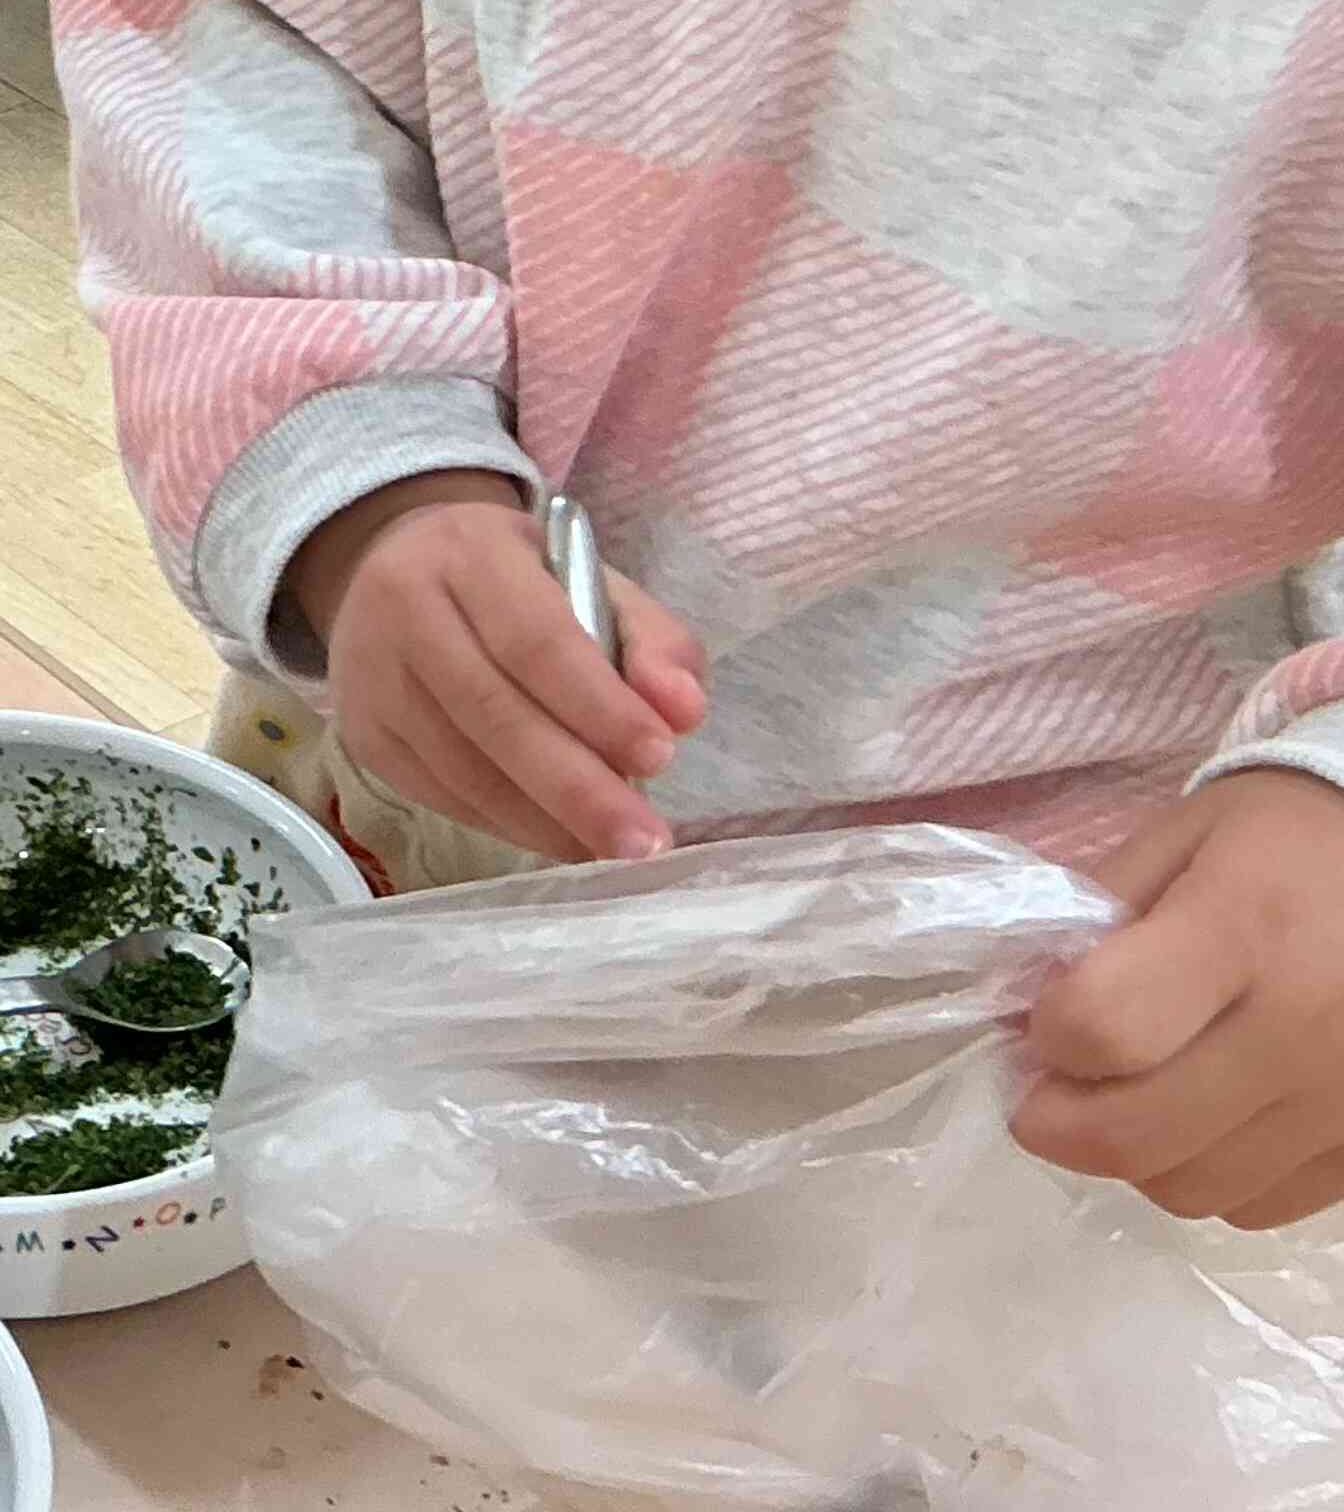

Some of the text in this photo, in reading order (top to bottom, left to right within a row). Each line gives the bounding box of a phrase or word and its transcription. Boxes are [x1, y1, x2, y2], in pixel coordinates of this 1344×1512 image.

[15, 1231, 45, 1255] M
[84, 1224, 120, 1253] N
[155, 1201, 182, 1226] O
